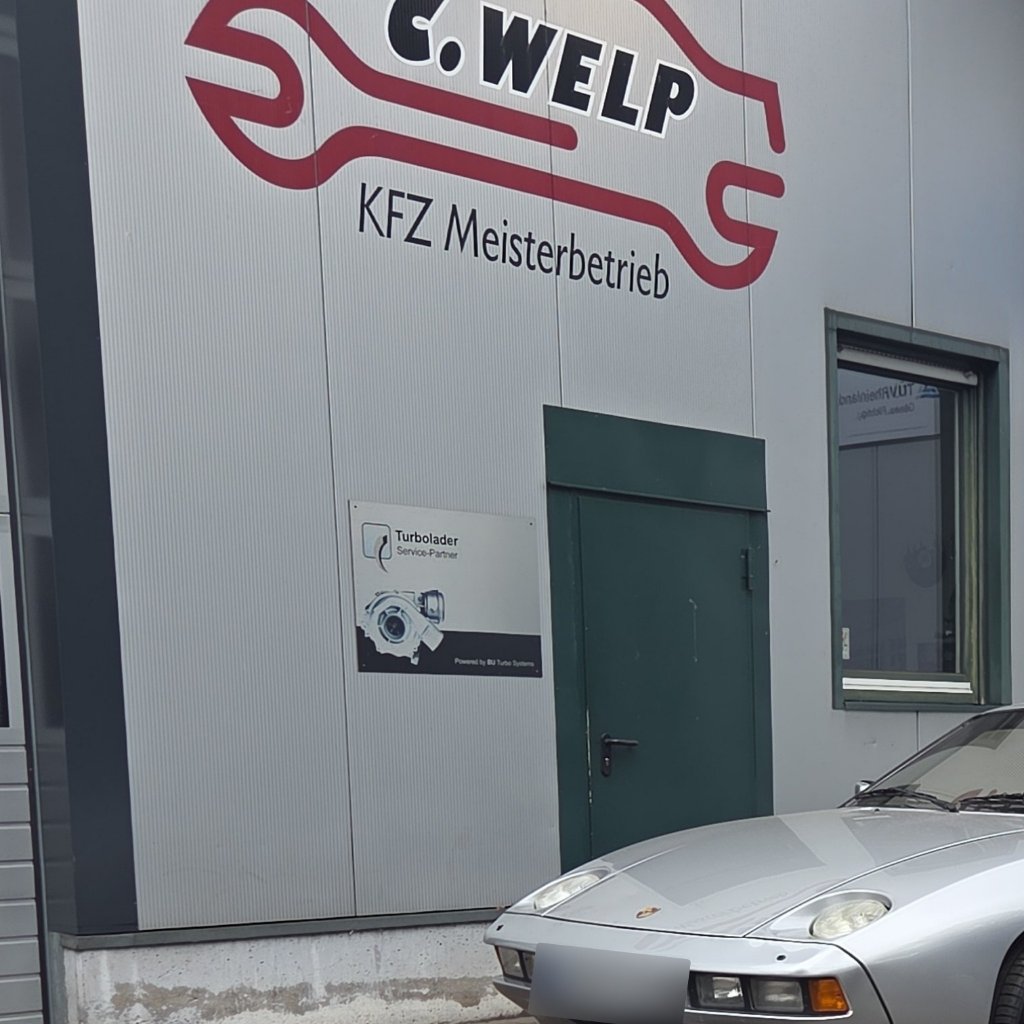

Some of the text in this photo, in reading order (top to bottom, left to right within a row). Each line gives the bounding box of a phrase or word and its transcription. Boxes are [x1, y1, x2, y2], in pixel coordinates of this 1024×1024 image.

[386, 0, 697, 138] C. WELP
[359, 182, 669, 299] KFZ Meisterbetrieb
[395, 530, 459, 546] Turbolader
[396, 546, 459, 559] Service-Partner
